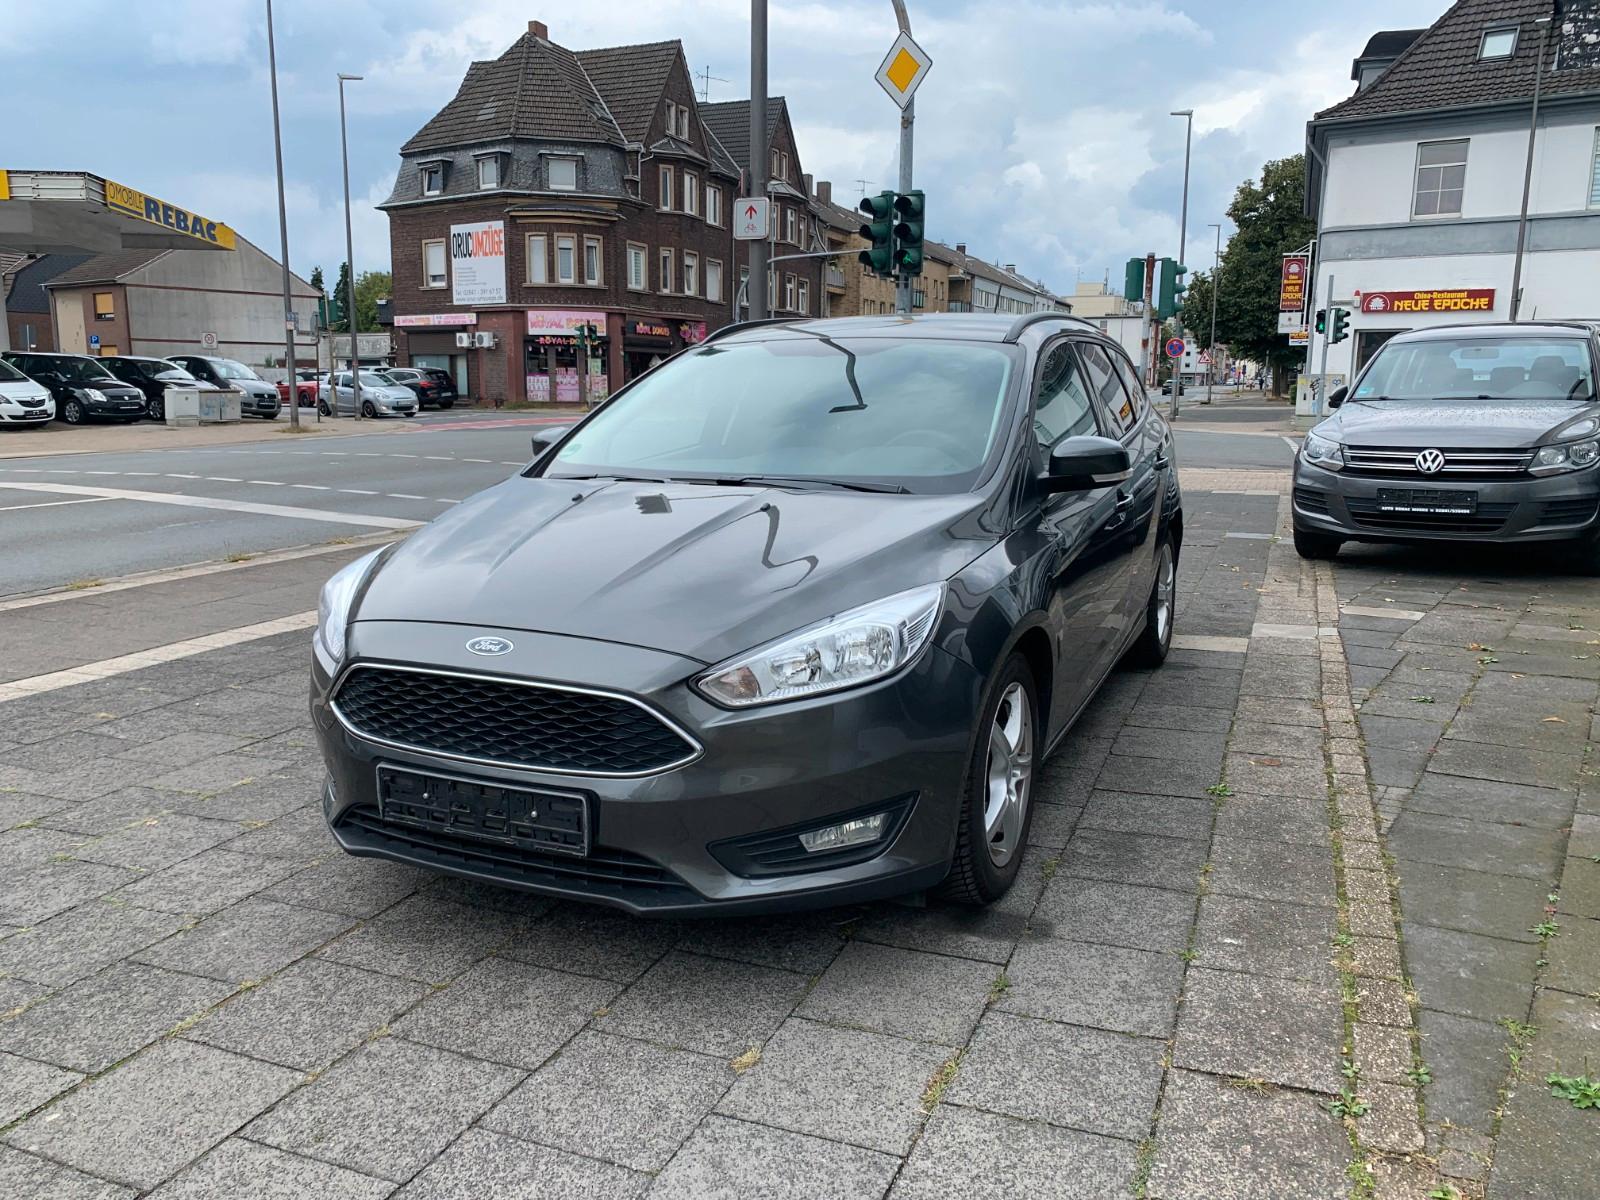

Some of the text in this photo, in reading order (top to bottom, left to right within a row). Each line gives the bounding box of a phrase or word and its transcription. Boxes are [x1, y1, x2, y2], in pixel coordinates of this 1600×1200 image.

[108, 182, 218, 242] OMOBILE REBAC
[1414, 291, 1468, 299] China-Restaurant
[1393, 297, 1489, 311] NEUE EPOCHE
[475, 640, 503, 651] Ford
